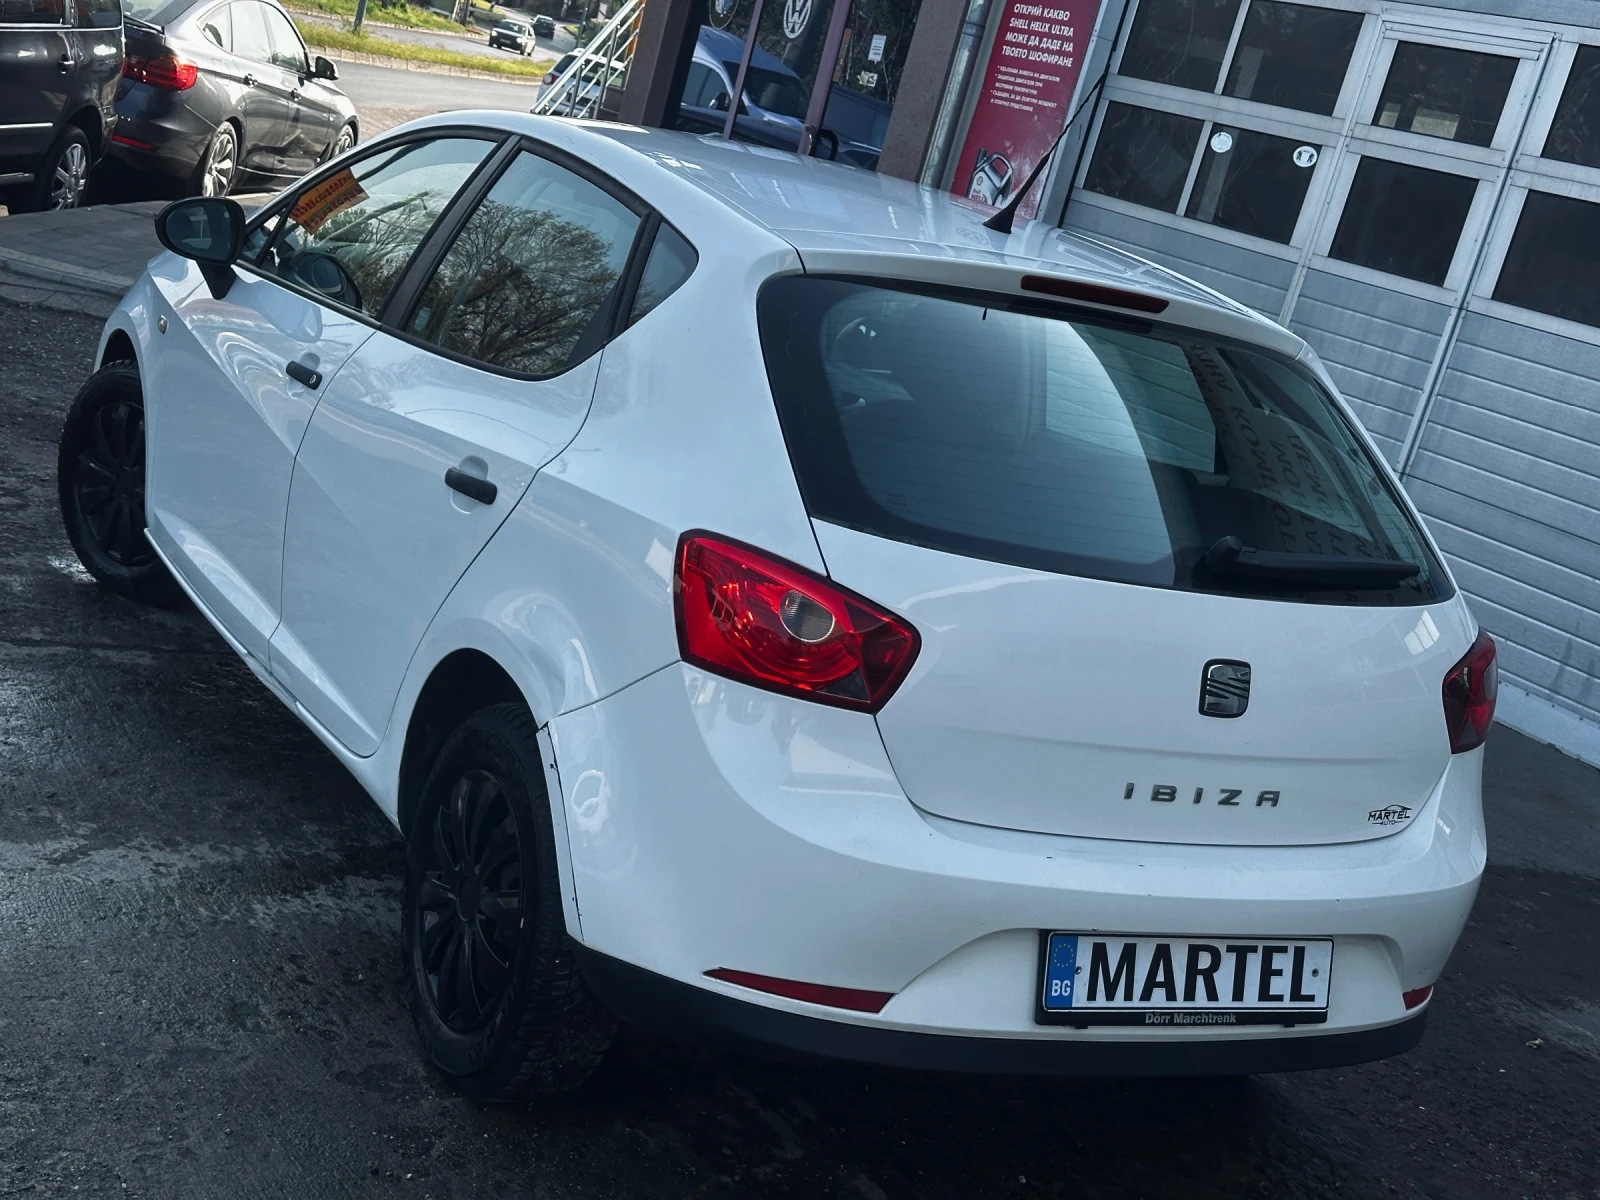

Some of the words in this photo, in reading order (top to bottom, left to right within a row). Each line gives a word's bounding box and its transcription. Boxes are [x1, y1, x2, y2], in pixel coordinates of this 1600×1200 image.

[1014, 3, 1043, 16] ОТКРИЙ
[1043, 8, 1070, 20] КАКВО
[1009, 18, 1028, 29] SHELL
[1030, 21, 1050, 33] HELIX
[1051, 24, 1074, 37] ULTRA
[1005, 32, 1028, 43] МОЖЕ
[1028, 35, 1039, 46] ДА
[1040, 37, 1062, 51] ДАДЕ
[1062, 41, 1073, 52] НА
[1001, 45, 1028, 58] ТВОЕТО
[1028, 50, 1073, 67] ШОФИРАНЕ
[1124, 782, 1281, 807] IBIZA
[1367, 809, 1411, 821] MARTEL
[1086, 941, 1316, 1002] MARTEL
[1051, 980, 1071, 997] BG
[1145, 1012, 1171, 1024] Dörr
[1173, 1012, 1237, 1024] Marchtrenk
